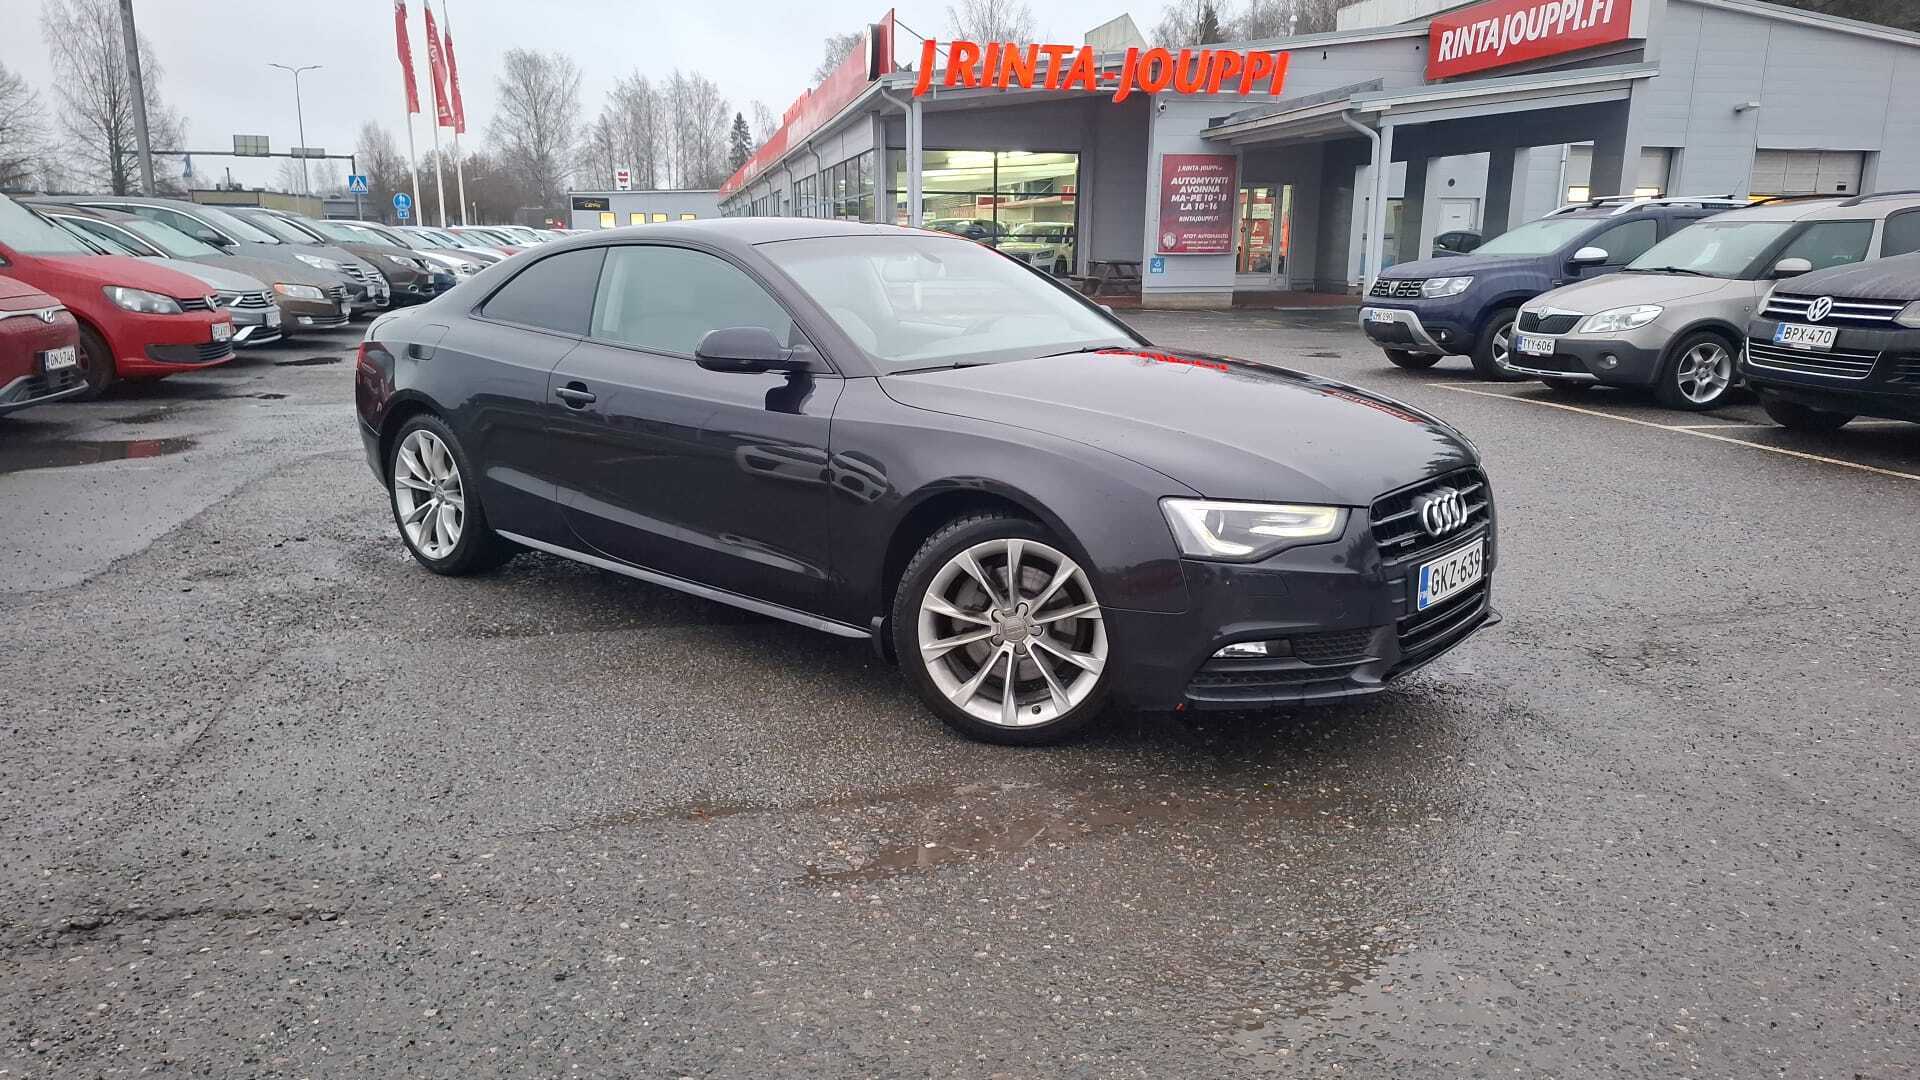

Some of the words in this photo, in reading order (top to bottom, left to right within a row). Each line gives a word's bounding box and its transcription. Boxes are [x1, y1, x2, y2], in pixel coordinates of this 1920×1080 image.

[944, 40, 1291, 104] RINTA-JOUPPI
[1171, 176, 1229, 184] AUTOMYYNTI
[1179, 185, 1220, 193] AVOINNA
[1170, 194, 1202, 202] MA-PE
[1180, 202, 1193, 211] LA
[1194, 202, 1218, 211] 10-16
[1783, 326, 1832, 344] BPX-470
[1522, 337, 1552, 353] TYY-606
[1431, 548, 1481, 596] GKZ-639
